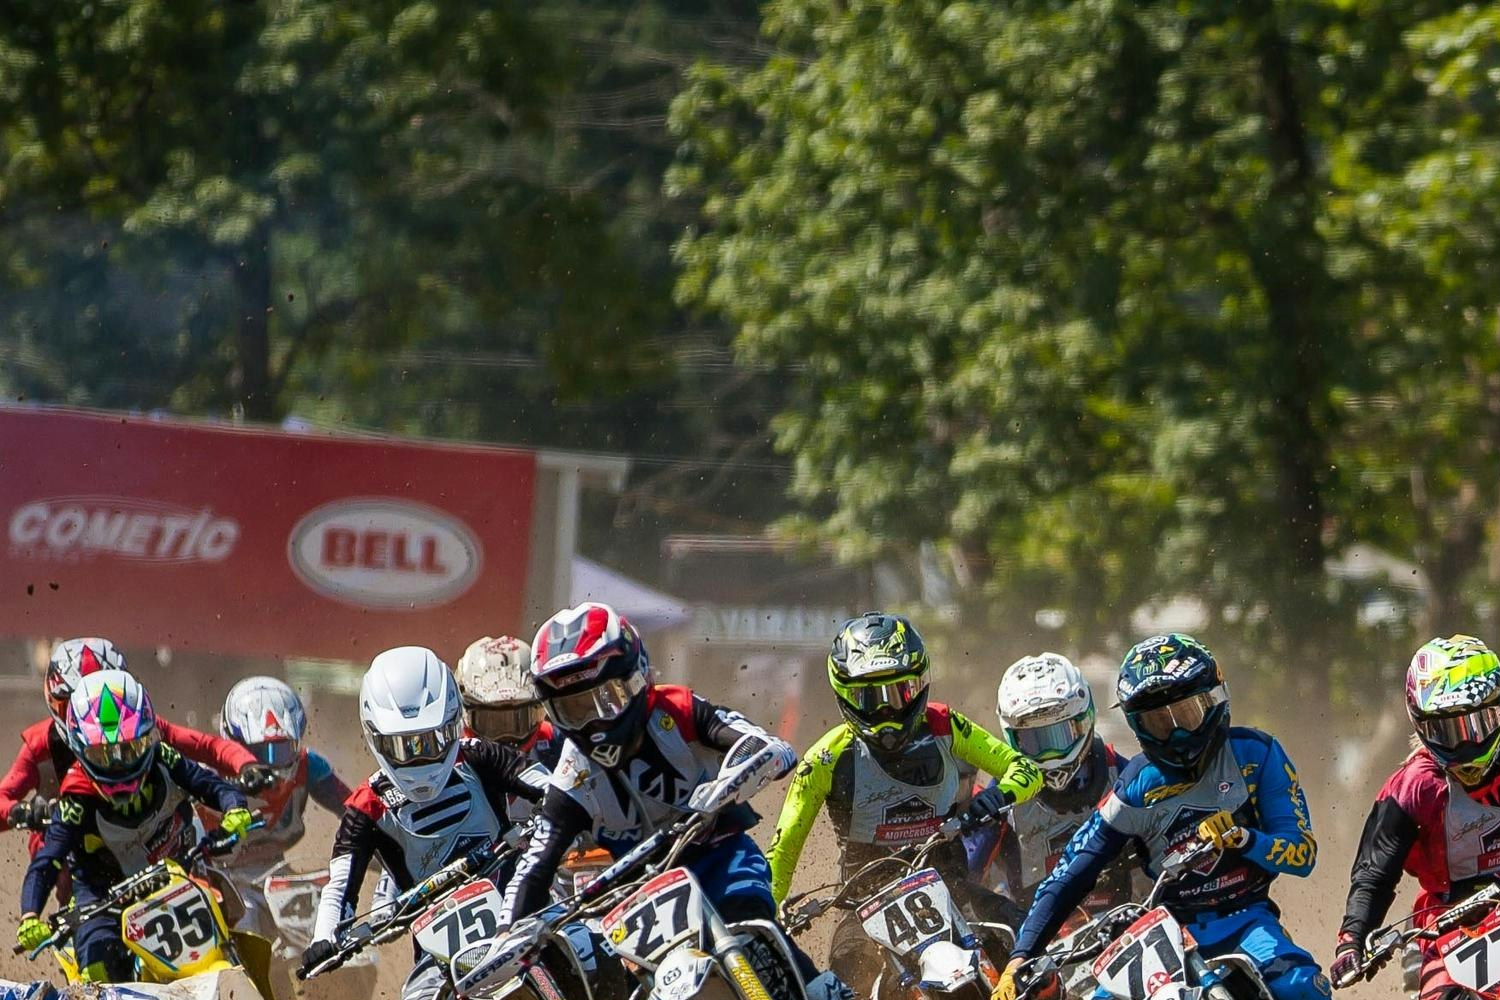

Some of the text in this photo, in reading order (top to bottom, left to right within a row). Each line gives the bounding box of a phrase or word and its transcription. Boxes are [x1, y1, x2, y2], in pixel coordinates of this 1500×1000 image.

[323, 528, 447, 575] BELL
[884, 825, 936, 840] MOTOCROSS
[143, 894, 213, 962] 35
[432, 897, 497, 958] 75
[624, 882, 692, 957] 27
[883, 891, 945, 948] 48
